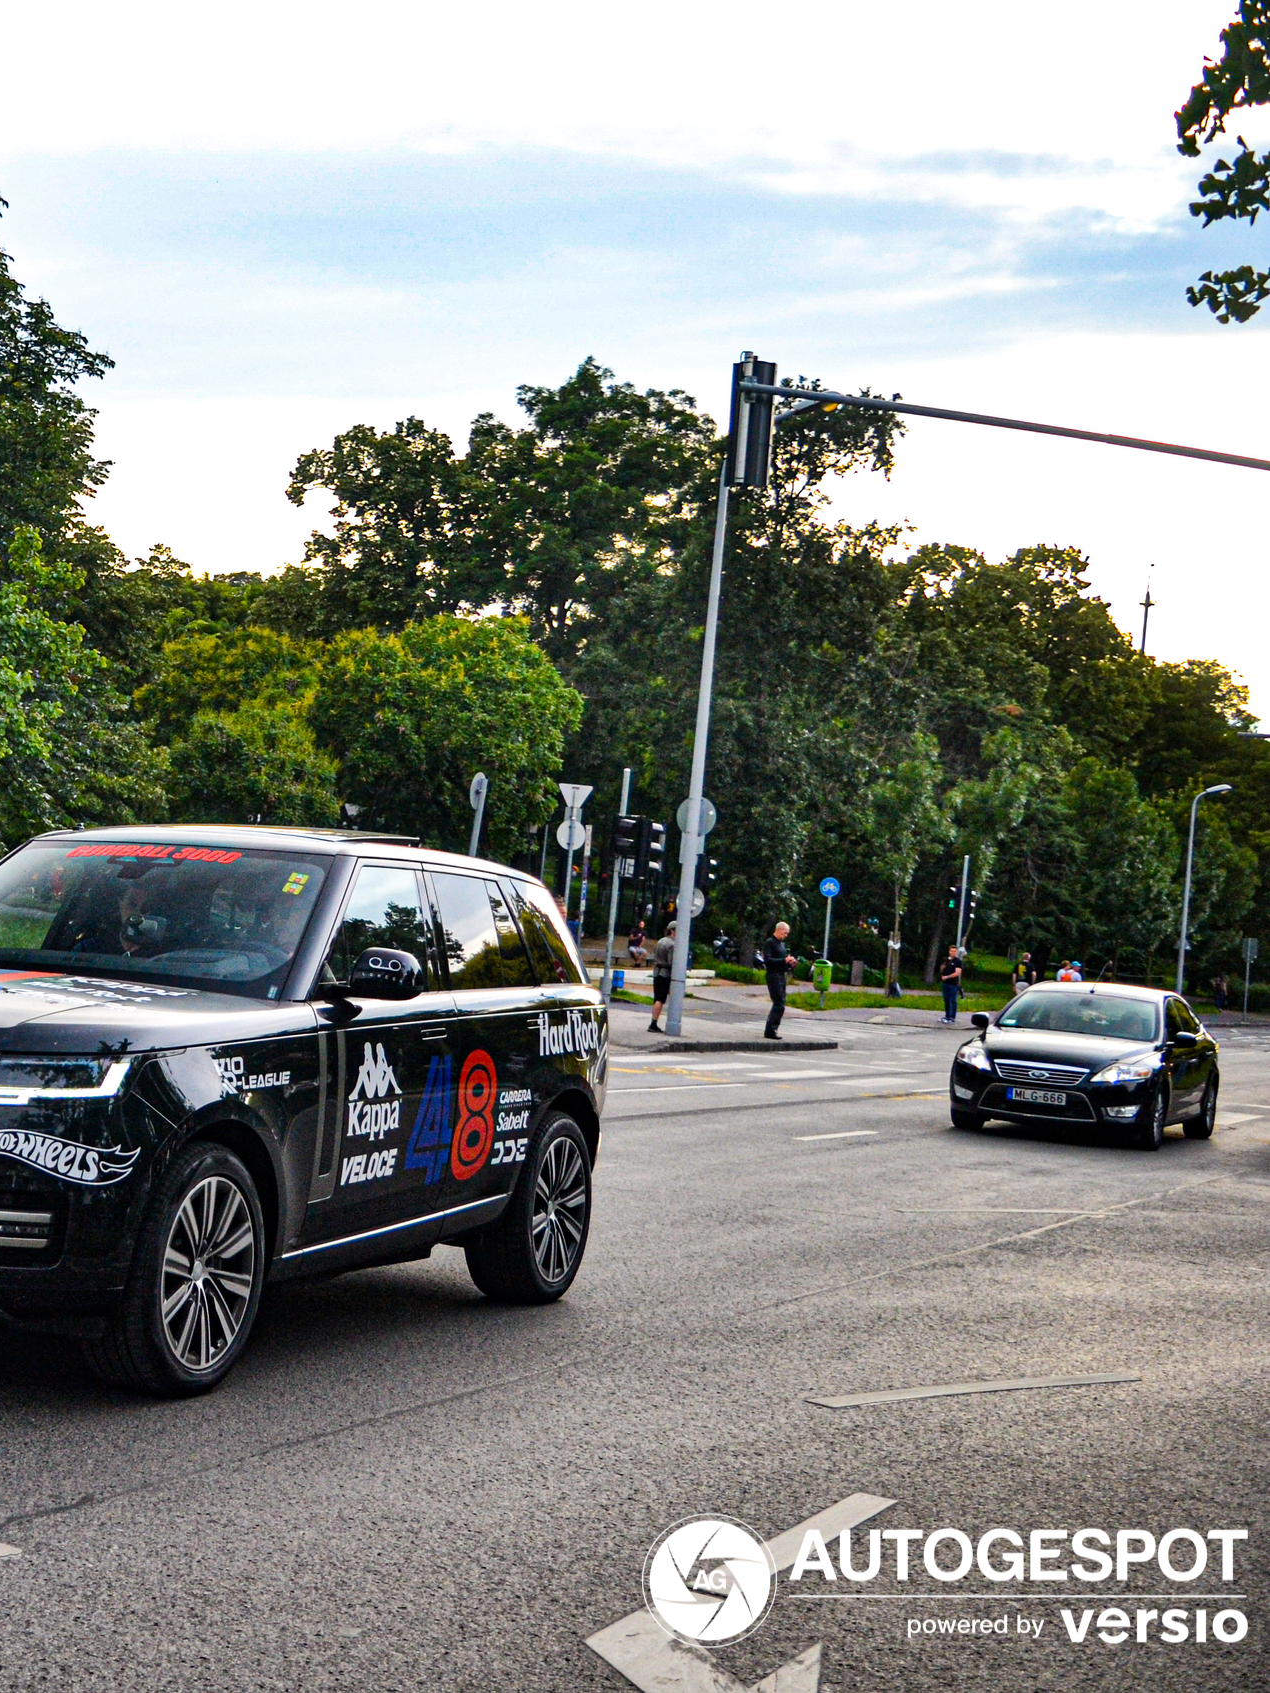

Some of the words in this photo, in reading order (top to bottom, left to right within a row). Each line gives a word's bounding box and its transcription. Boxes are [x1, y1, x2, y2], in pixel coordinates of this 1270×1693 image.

[66, 844, 171, 859] GUMBALL
[172, 847, 243, 865] 3000
[537, 1010, 575, 1057] Hard
[570, 1008, 601, 1060] Rock
[499, 1088, 532, 1105] CARRERA
[1014, 1089, 1064, 1104] MLG-666
[346, 1099, 400, 1142] Kappa
[403, 1049, 498, 1186] 48
[496, 1110, 530, 1132] Sabelt
[340, 1147, 399, 1187] VELOCE
